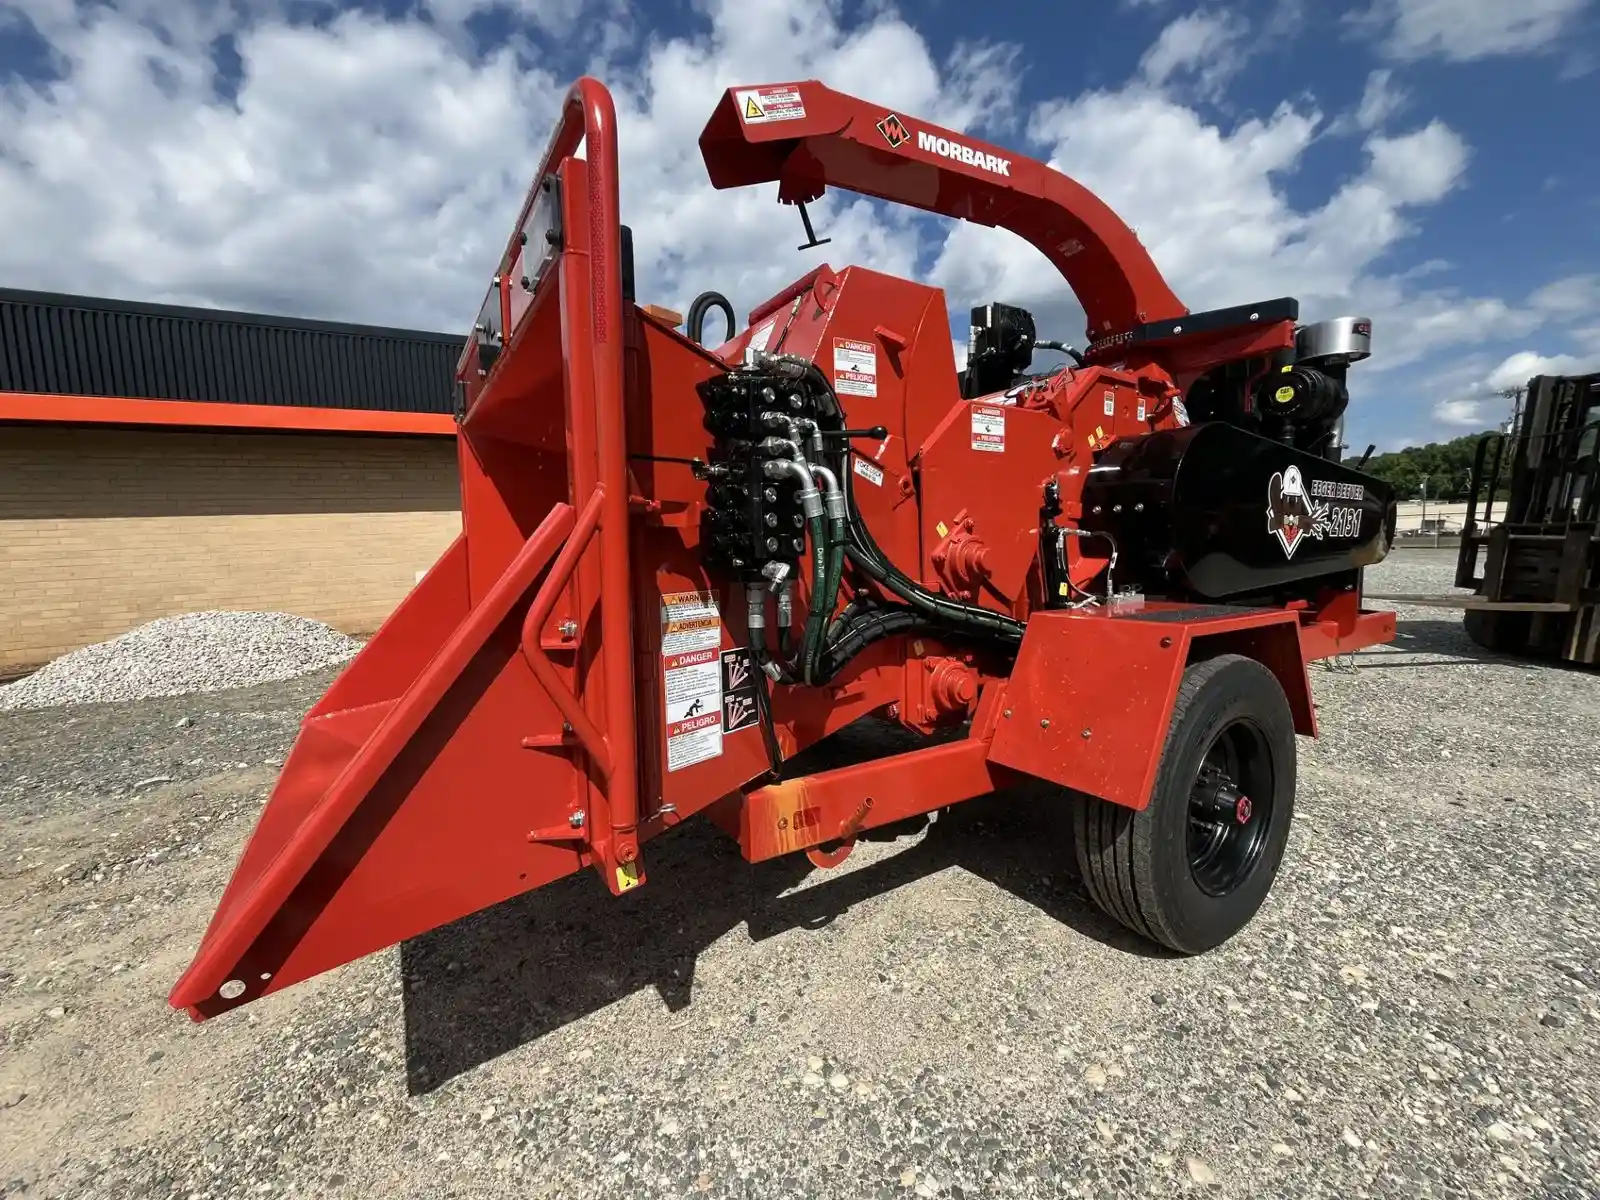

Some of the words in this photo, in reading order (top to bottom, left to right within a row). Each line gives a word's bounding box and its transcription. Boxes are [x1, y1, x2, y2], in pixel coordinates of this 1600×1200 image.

[918, 131, 1010, 176] MORBARK
[845, 341, 872, 352] DANGER
[845, 372, 873, 383] PELIGRO
[1329, 507, 1362, 537] 2131
[680, 651, 713, 665] DANGER
[681, 715, 716, 731] PELIGRO
